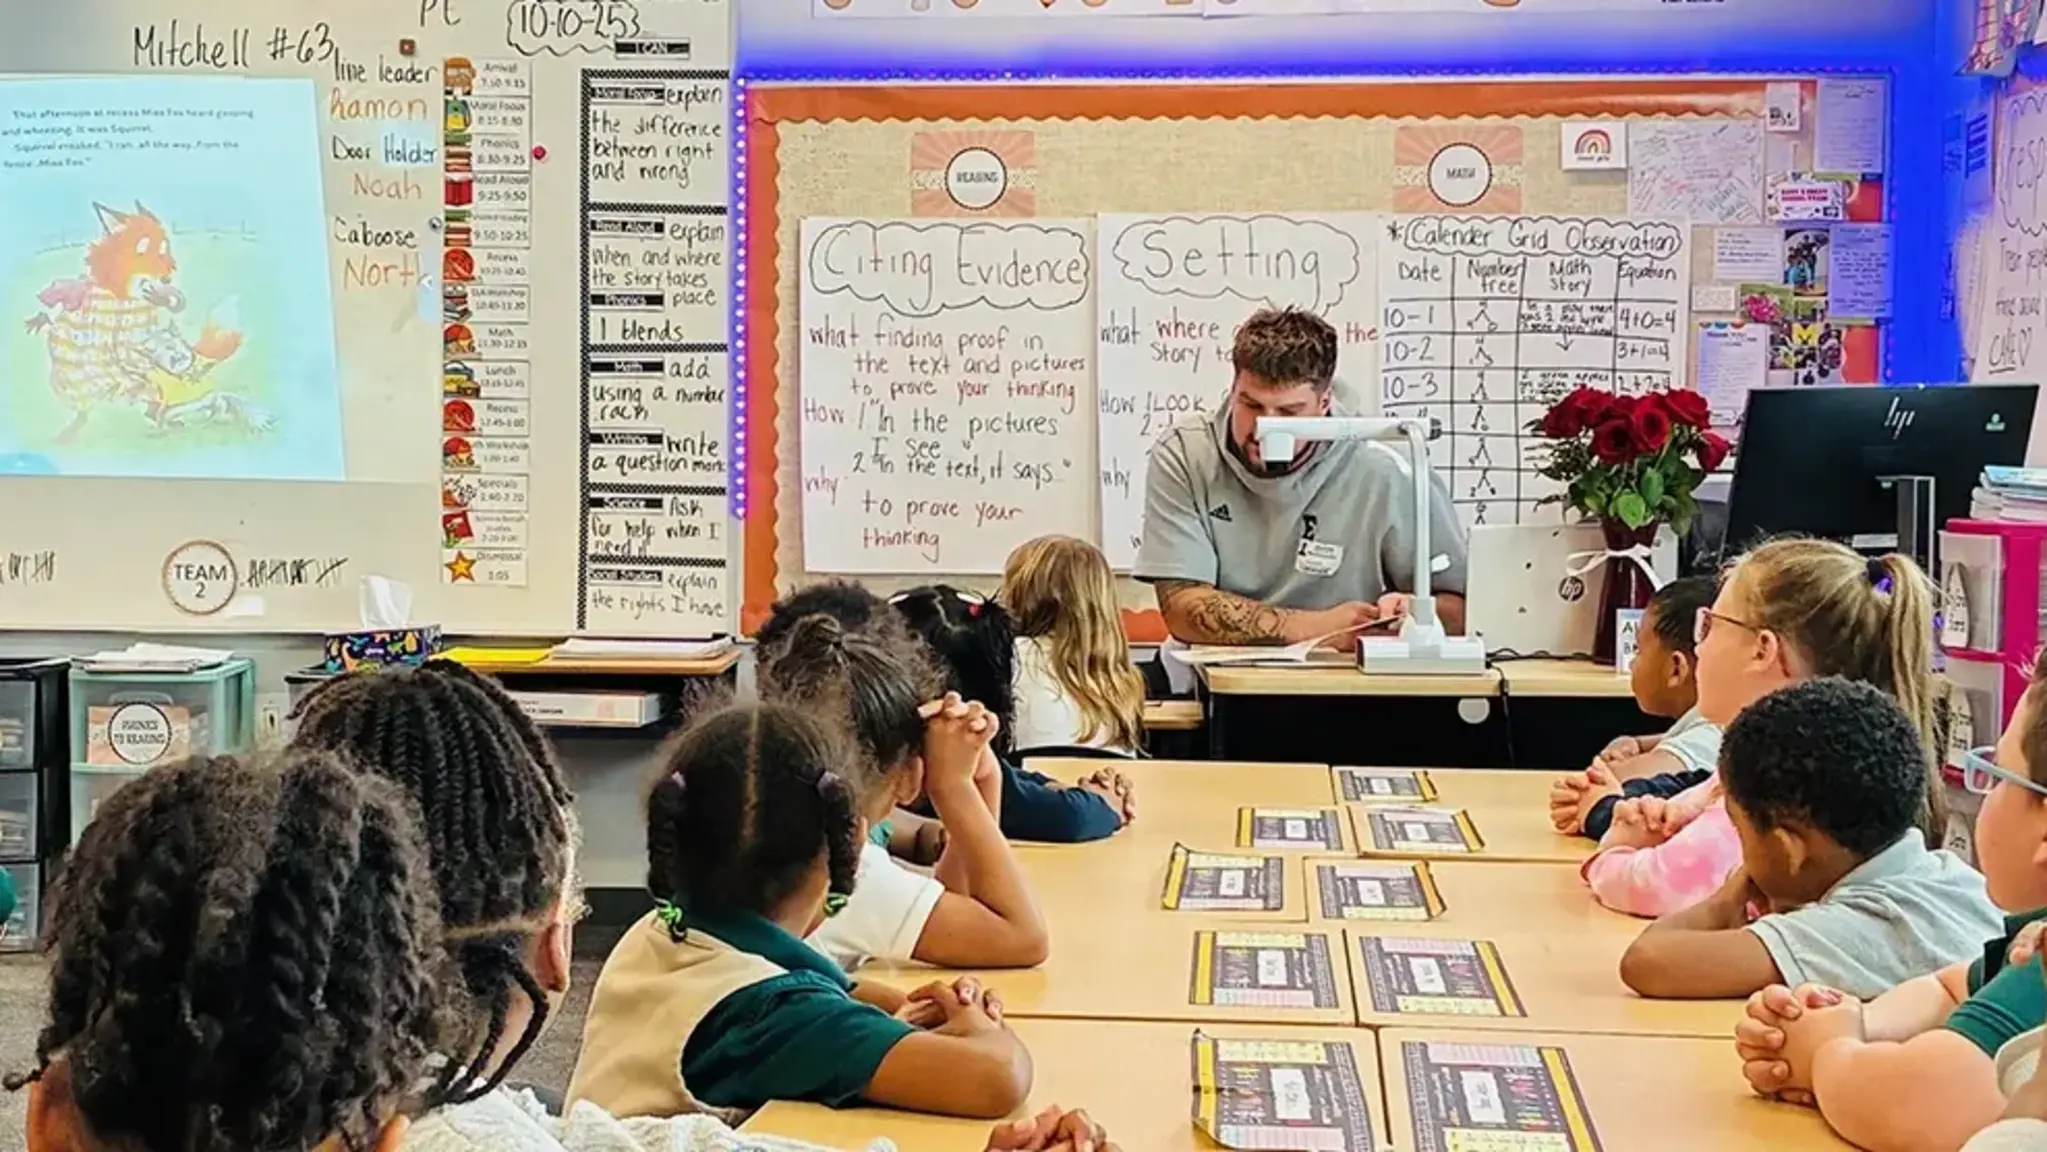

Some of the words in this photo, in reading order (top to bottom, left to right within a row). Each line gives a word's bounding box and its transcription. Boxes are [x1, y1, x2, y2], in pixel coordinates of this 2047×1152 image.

[133, 19, 249, 68] Mitchell
[267, 22, 334, 62] #63
[335, 48, 367, 83] line
[379, 54, 438, 83] leader
[667, 85, 722, 112] explain
[592, 110, 620, 133] the
[634, 115, 722, 137] difference
[332, 135, 370, 160] Door
[384, 132, 438, 163] Holder
[593, 136, 656, 158] between
[666, 142, 714, 166] right
[354, 170, 422, 199] Noah
[592, 160, 625, 182] and
[640, 166, 690, 189] wrong
[957, 171, 998, 183] READING
[1446, 167, 1476, 179] MATH
[334, 215, 418, 249] Caboose
[670, 219, 724, 248] explain
[1411, 219, 1493, 247] Calender
[1508, 219, 1549, 249] Grid
[1566, 222, 1676, 251] Observation
[641, 247, 670, 265] and
[675, 250, 722, 266] where
[825, 228, 932, 311] Citing
[957, 229, 1085, 288] Evidence
[1143, 223, 1321, 310] Setting
[1399, 256, 1442, 281] Date
[1467, 257, 1522, 279] Number
[1549, 259, 1592, 276] Math
[593, 268, 616, 286] the
[666, 270, 707, 288] takes
[1619, 258, 1677, 287] Equation
[672, 289, 717, 307] place
[621, 318, 684, 341] blends
[874, 313, 944, 352] finding
[958, 325, 1009, 355] proof
[1024, 331, 1044, 350] in
[1157, 306, 1220, 340] where
[1345, 322, 1379, 344] the
[854, 351, 889, 374] the
[909, 354, 951, 375] text
[964, 355, 1001, 375] and
[1010, 354, 1085, 378] pictures
[593, 385, 642, 405] using
[652, 386, 667, 400] a
[676, 385, 725, 403] number
[850, 377, 873, 396] to
[890, 377, 937, 400] prove
[956, 379, 989, 406] your
[1007, 379, 1076, 415] thinking
[1101, 389, 1135, 414] How
[804, 398, 845, 424] How
[912, 407, 948, 433] the
[968, 410, 1058, 439] pictures
[666, 430, 718, 457] write
[592, 455, 607, 470] a
[615, 452, 688, 476] question
[907, 457, 937, 476] the
[990, 450, 1003, 478] it
[862, 490, 892, 516] to
[907, 501, 960, 523] prove
[975, 502, 1023, 528] your
[592, 514, 611, 537] for
[625, 518, 656, 543] help
[666, 520, 700, 538] when
[709, 522, 721, 540] I
[863, 527, 939, 563] thinking
[174, 564, 227, 581] TEAM
[668, 572, 718, 597] explain
[195, 582, 205, 598] 2
[592, 589, 613, 609] the
[620, 592, 666, 620] rights
[689, 597, 725, 618] have
